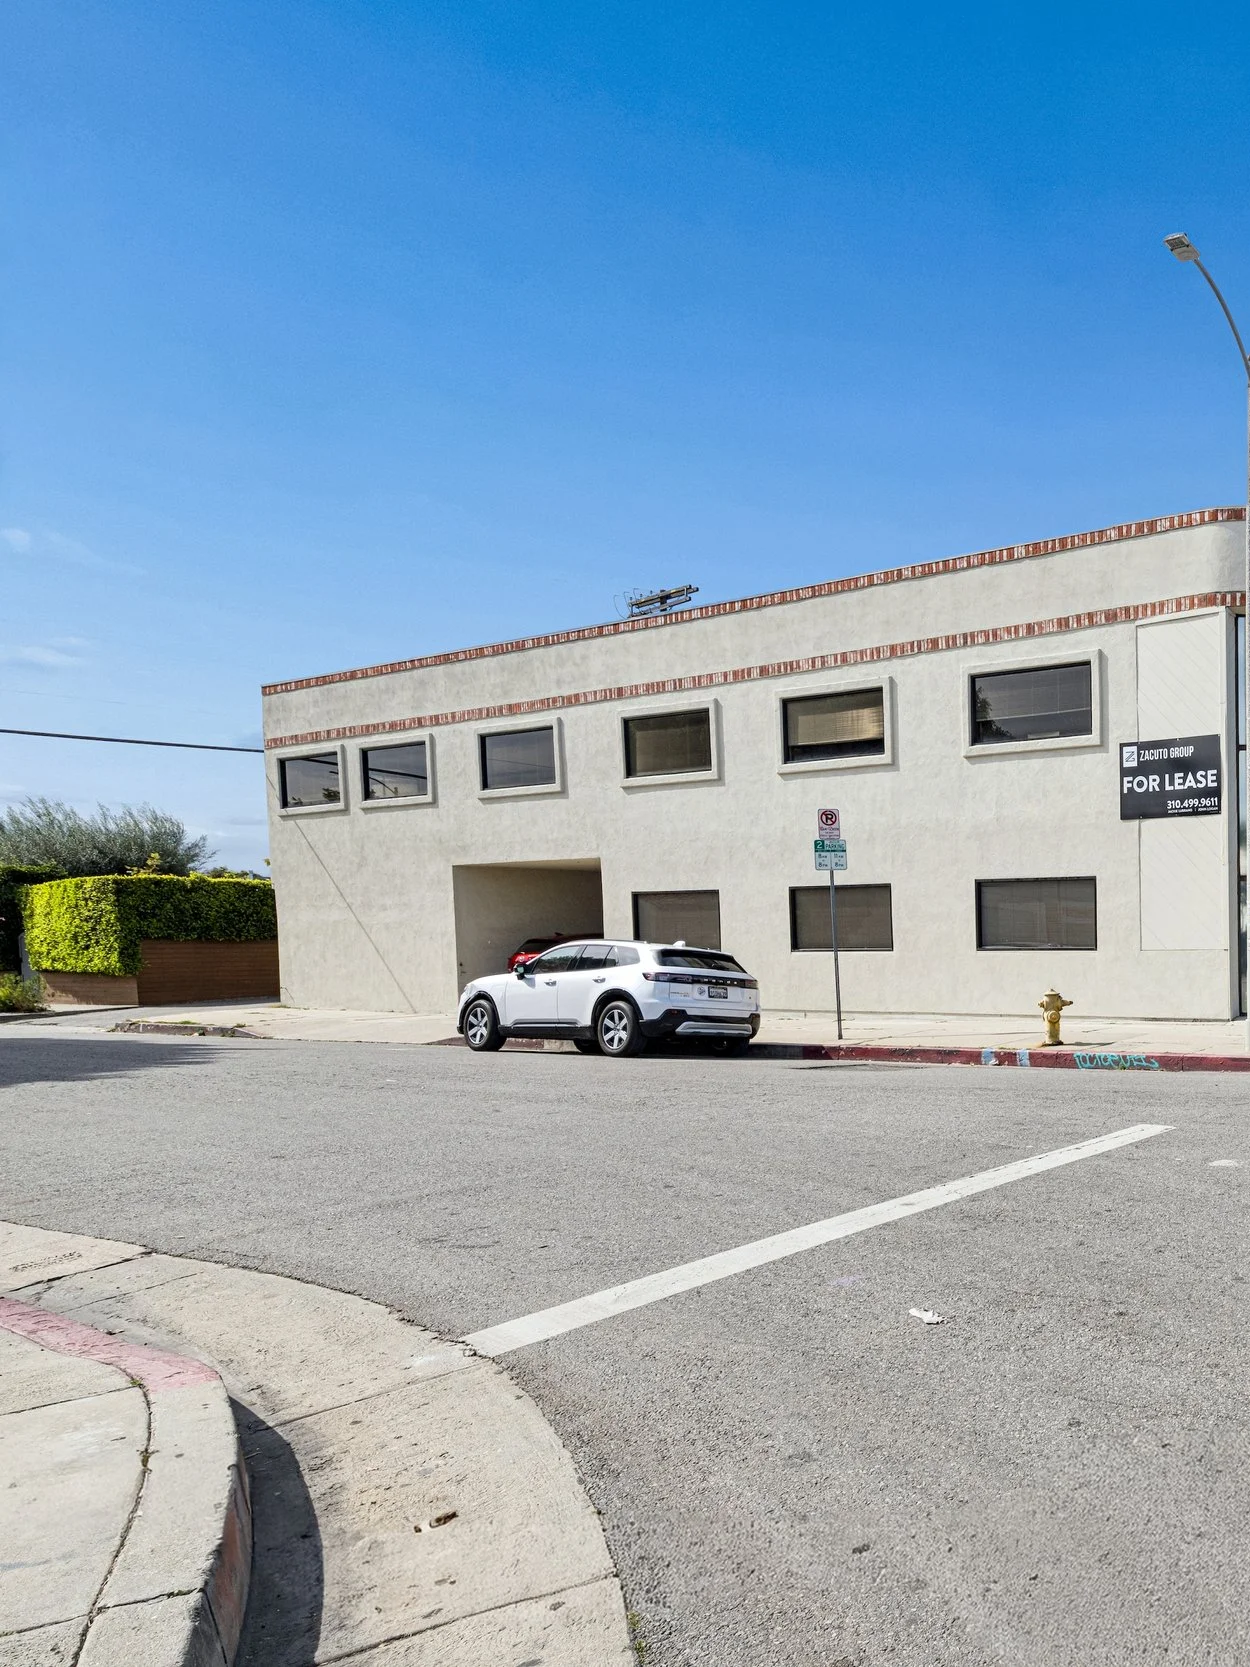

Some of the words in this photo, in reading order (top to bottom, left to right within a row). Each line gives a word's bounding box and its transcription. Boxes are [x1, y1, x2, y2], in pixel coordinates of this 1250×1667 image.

[1139, 749, 1168, 761] ZACUTO
[1169, 745, 1194, 758] GROUP
[1123, 774, 1160, 794] FOR
[1164, 769, 1218, 791] LEASE
[1166, 797, 1218, 809] 310.499.9611
[816, 841, 823, 849] 2
